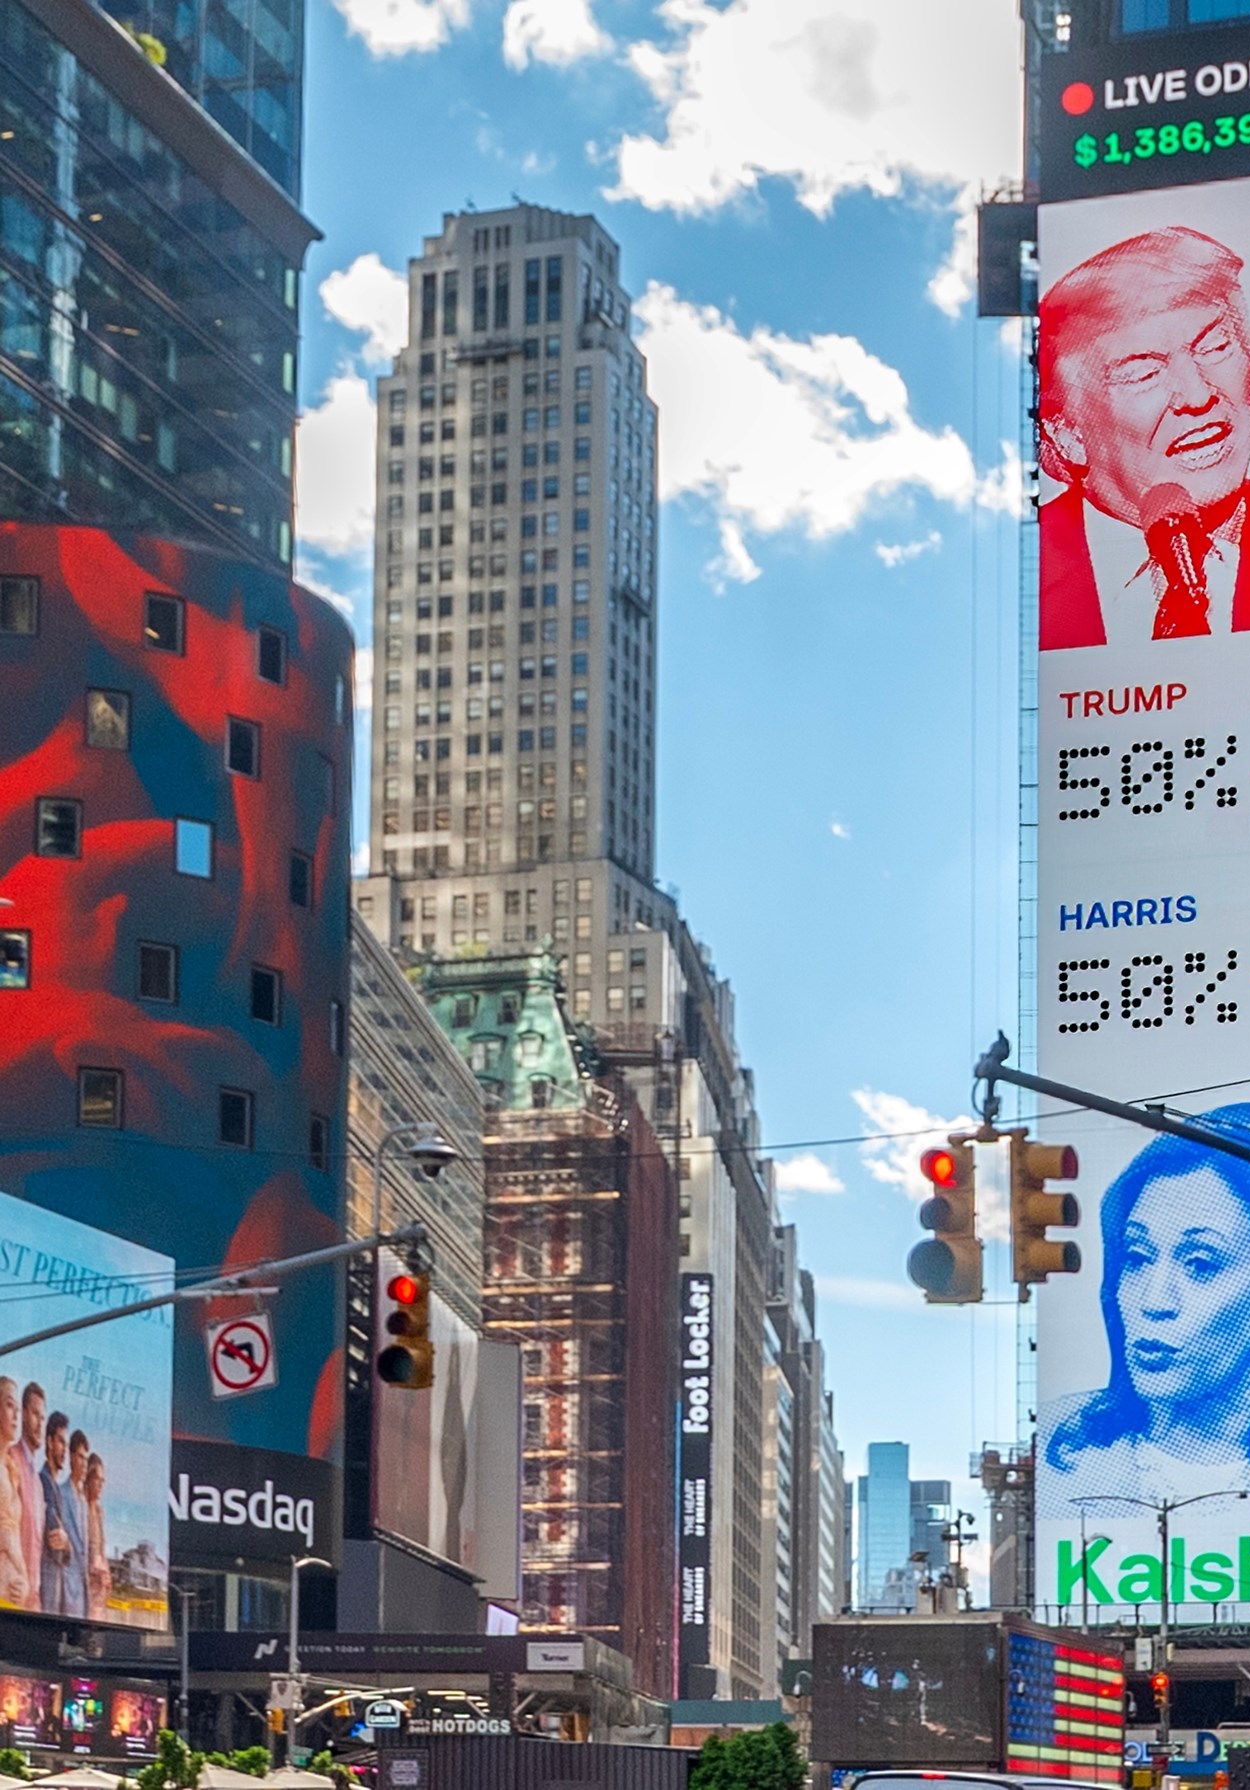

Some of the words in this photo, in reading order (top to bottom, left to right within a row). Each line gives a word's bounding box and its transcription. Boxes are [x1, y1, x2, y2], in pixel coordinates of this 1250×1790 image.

[1104, 69, 1187, 109] LIVE
[1059, 682, 1187, 719] TRUMP
[1058, 735, 1237, 820] 50%
[1059, 895, 1197, 931] HARRIS
[1058, 950, 1237, 1033] 50%
[683, 1280, 710, 1369] Locker
[62, 1364, 146, 1412] PERFECT
[683, 1376, 710, 1433] Foot
[168, 1473, 314, 1548] Nasdaq
[684, 1479, 695, 1514] HEART
[684, 1516, 695, 1536] THE
[683, 1567, 694, 1602] HEART
[683, 1604, 694, 1624] THE
[431, 1718, 512, 1733] HOTDOGS
